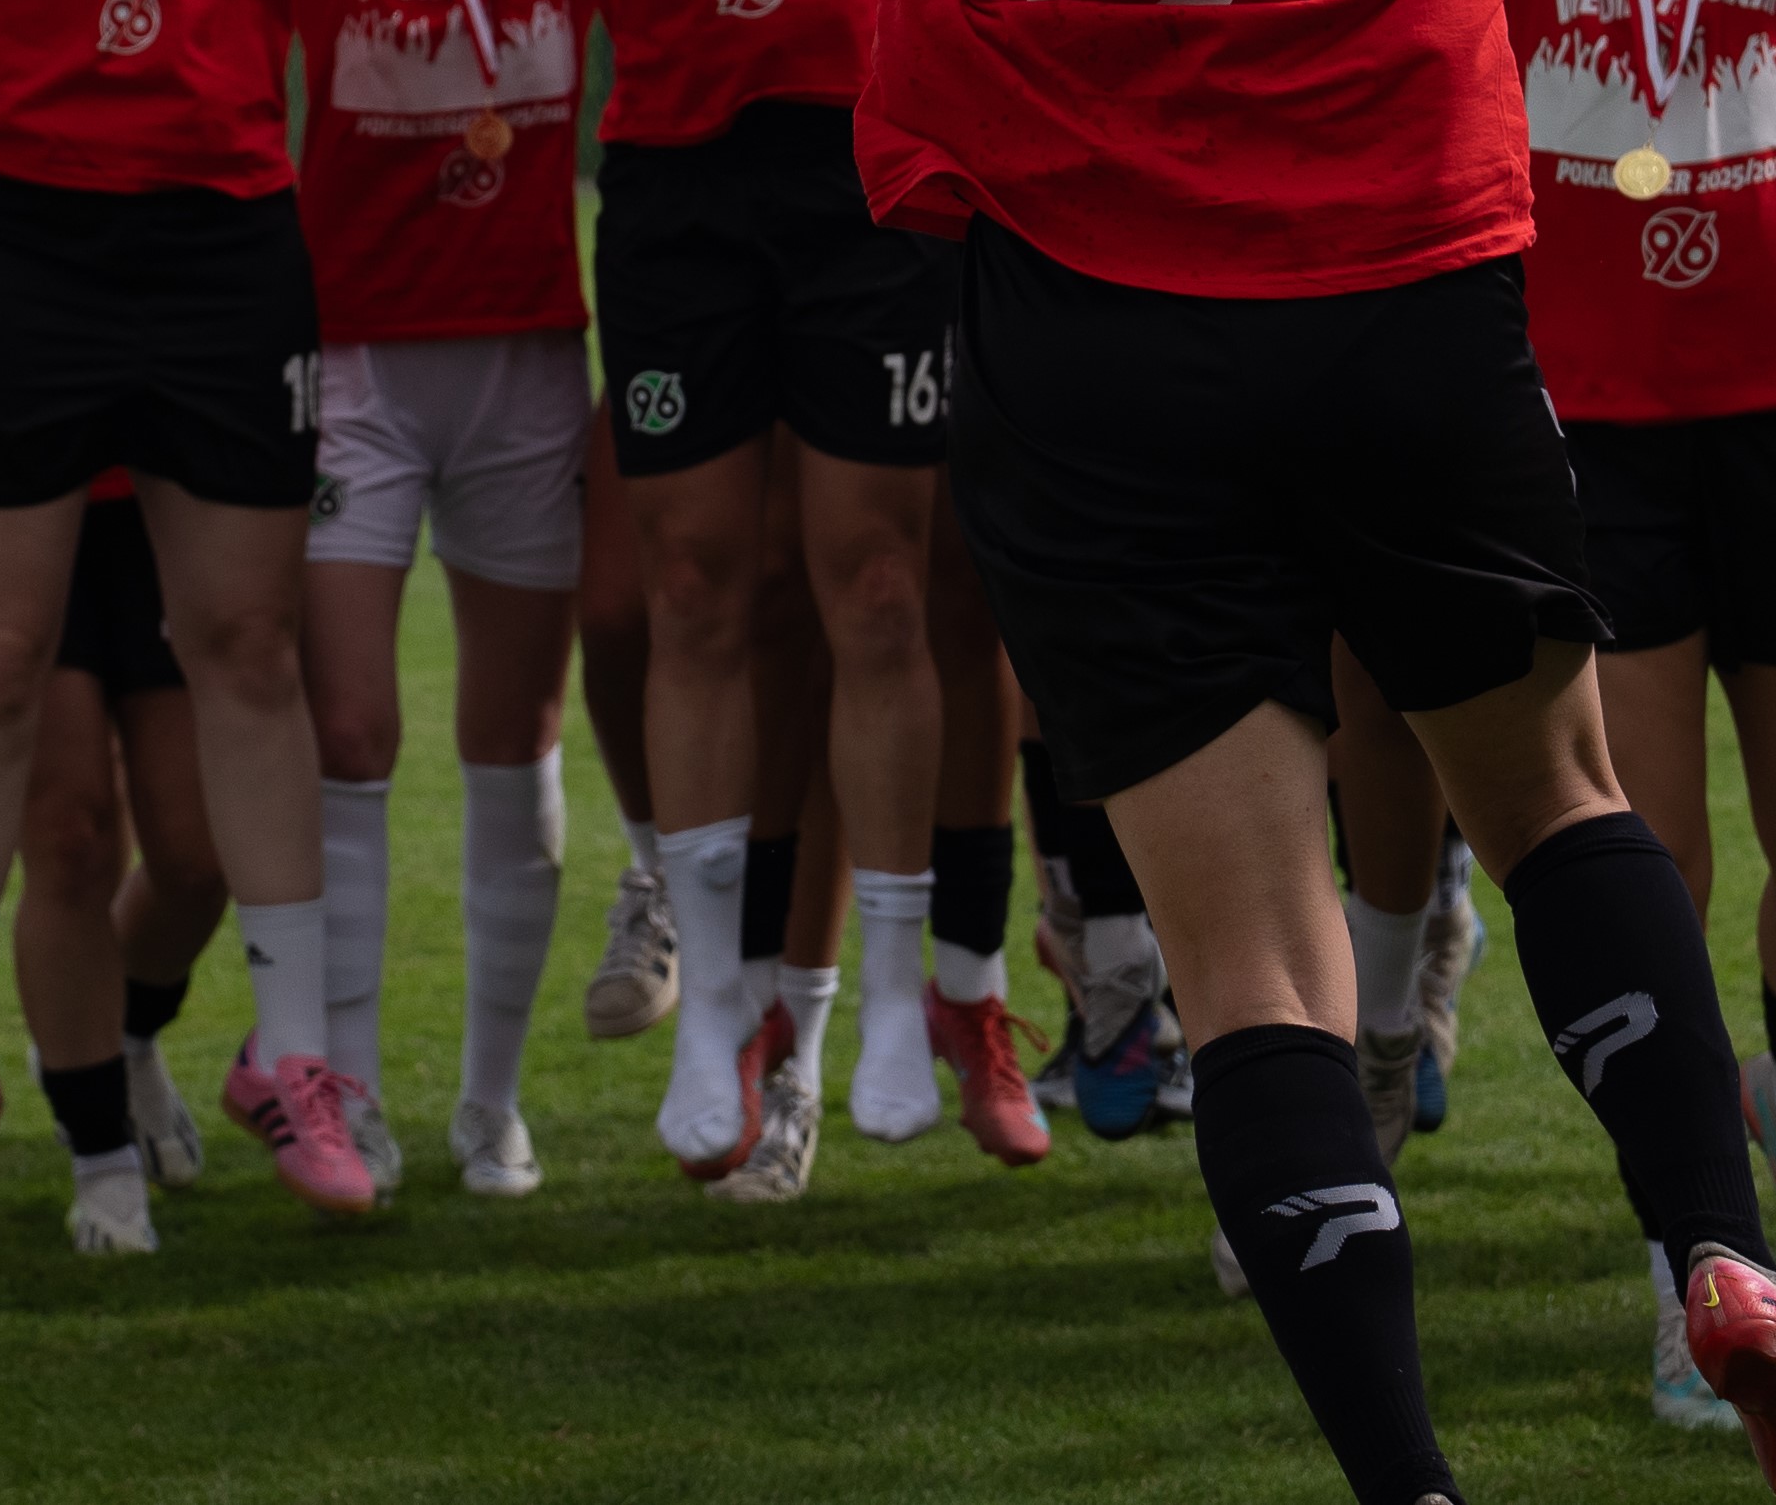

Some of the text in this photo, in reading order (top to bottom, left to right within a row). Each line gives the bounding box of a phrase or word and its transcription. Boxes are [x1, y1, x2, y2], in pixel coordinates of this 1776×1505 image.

[1642, 206, 1720, 289] 96
[626, 369, 688, 436] 96
[881, 350, 940, 428] 16
